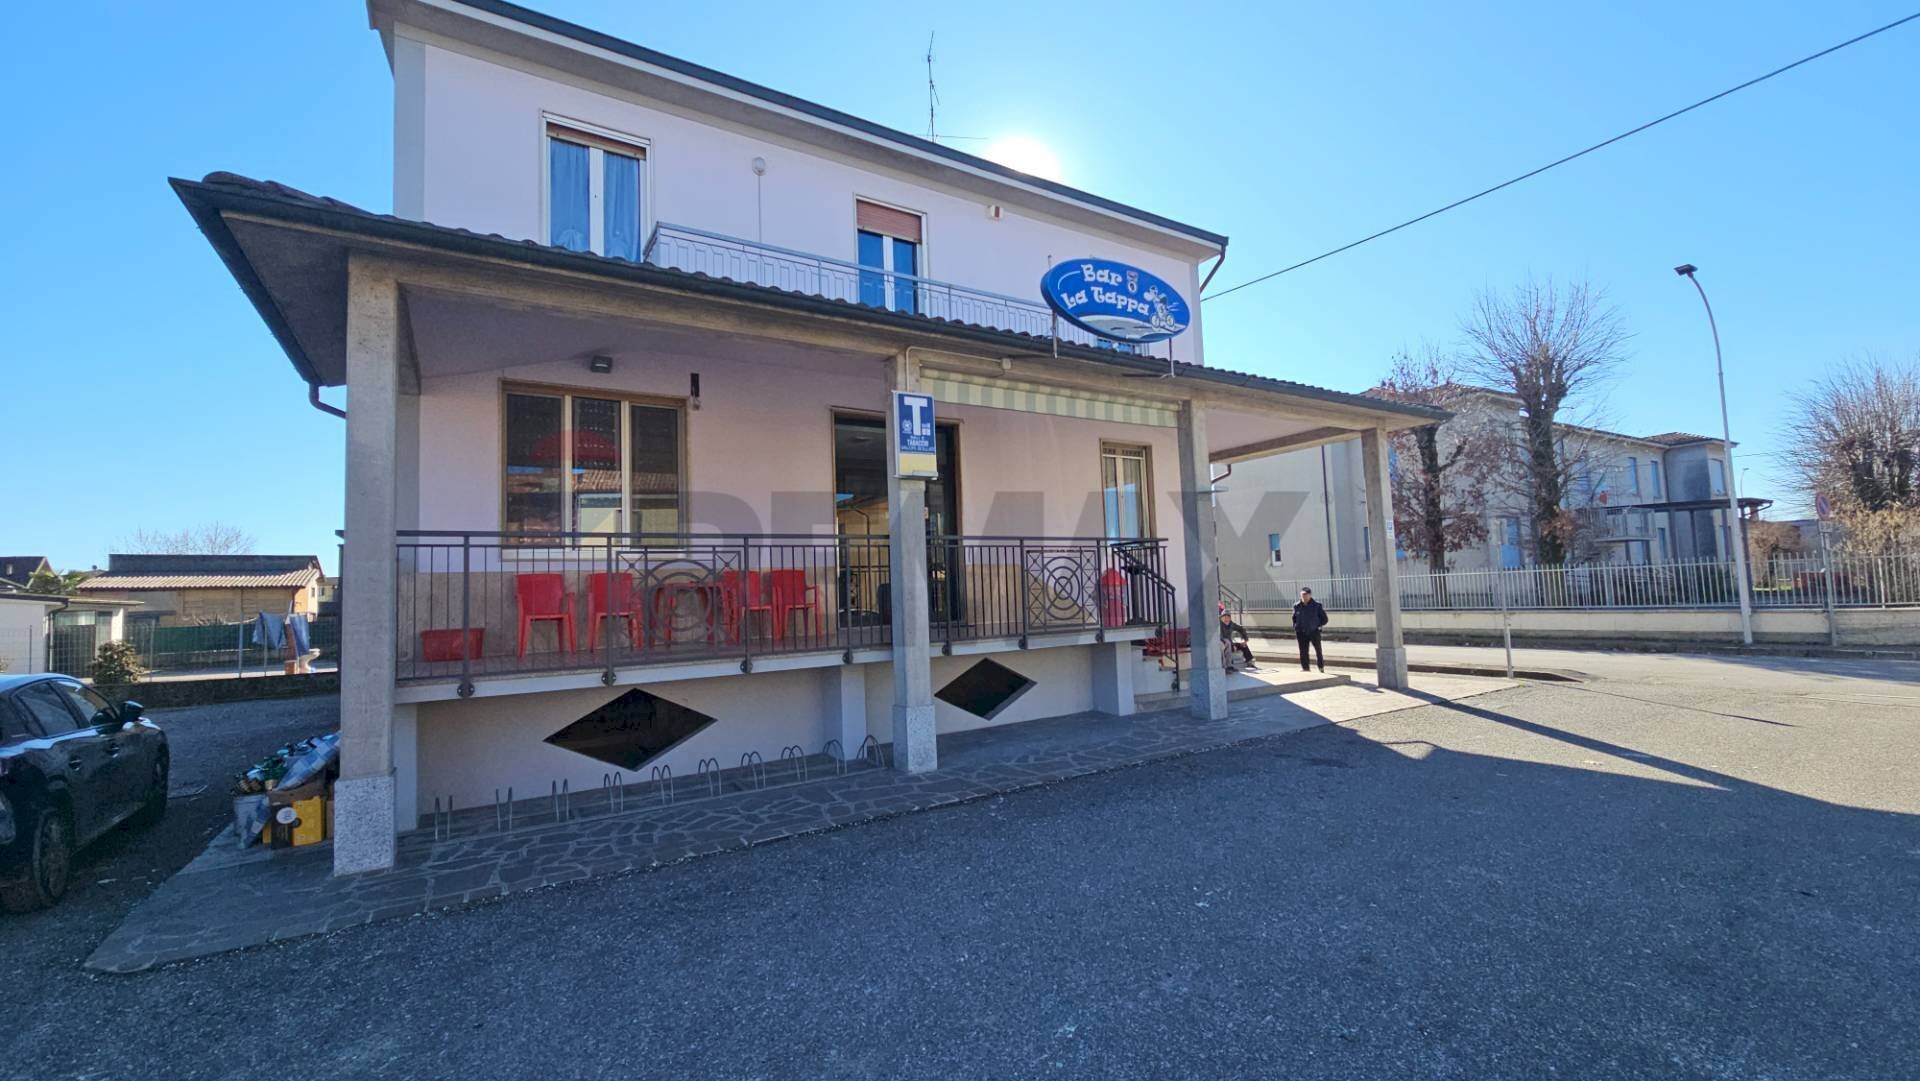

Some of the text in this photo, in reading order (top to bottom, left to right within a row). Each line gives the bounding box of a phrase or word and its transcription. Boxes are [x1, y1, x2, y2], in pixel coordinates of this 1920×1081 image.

[1081, 264, 1122, 286] Bar
[1061, 287, 1149, 315] La Tappa
[904, 396, 928, 436] T
